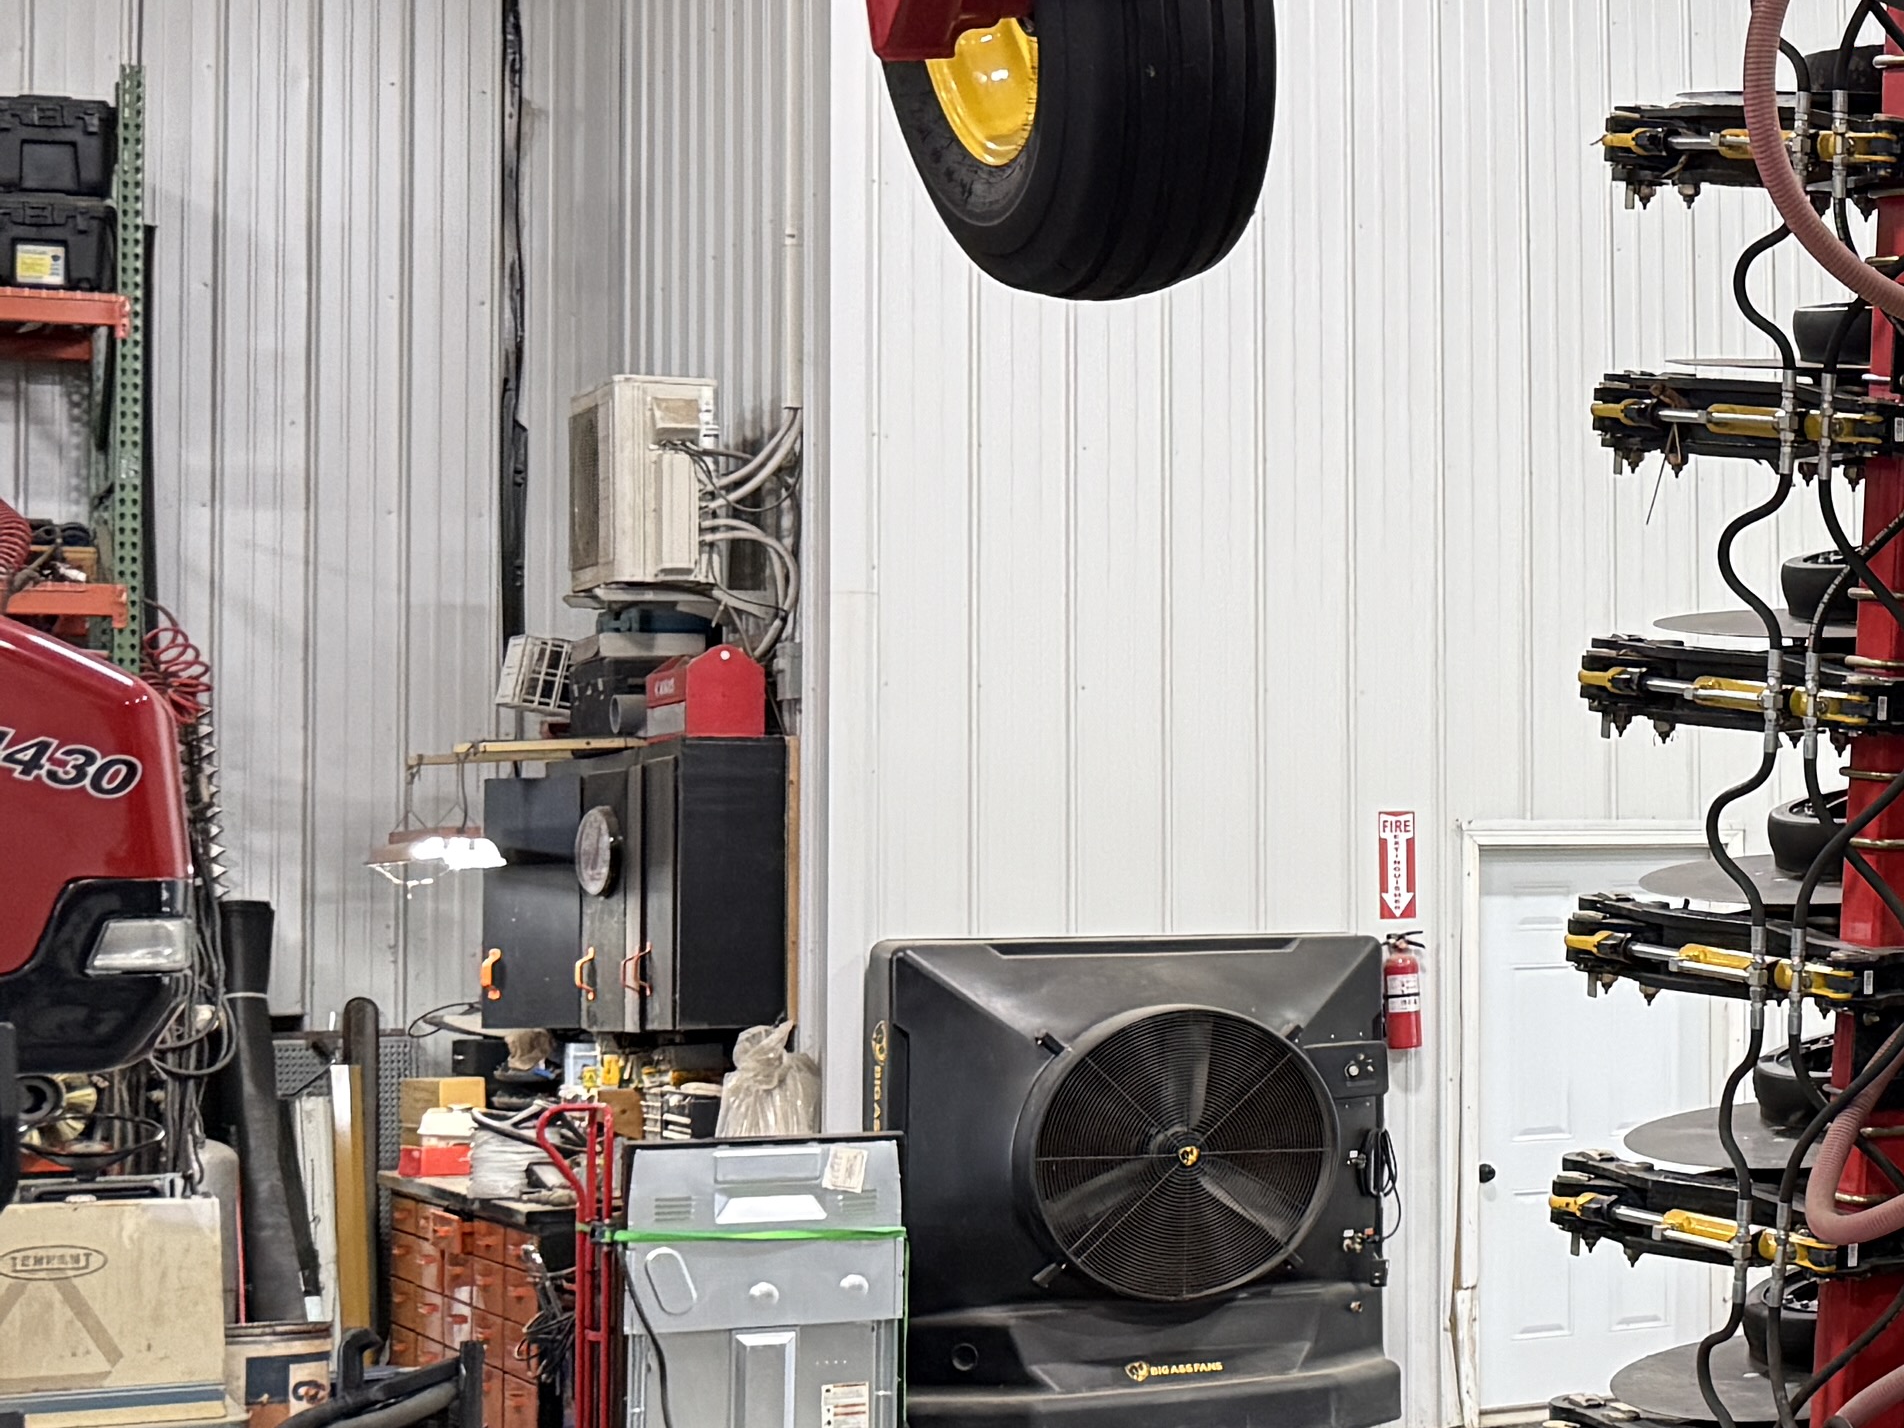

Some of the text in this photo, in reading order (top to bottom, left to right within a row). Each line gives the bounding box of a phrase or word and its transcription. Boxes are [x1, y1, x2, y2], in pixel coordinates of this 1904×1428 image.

[1382, 820, 1412, 833] FIRE
[1150, 1361, 1223, 1376] BIG ASS FANS
